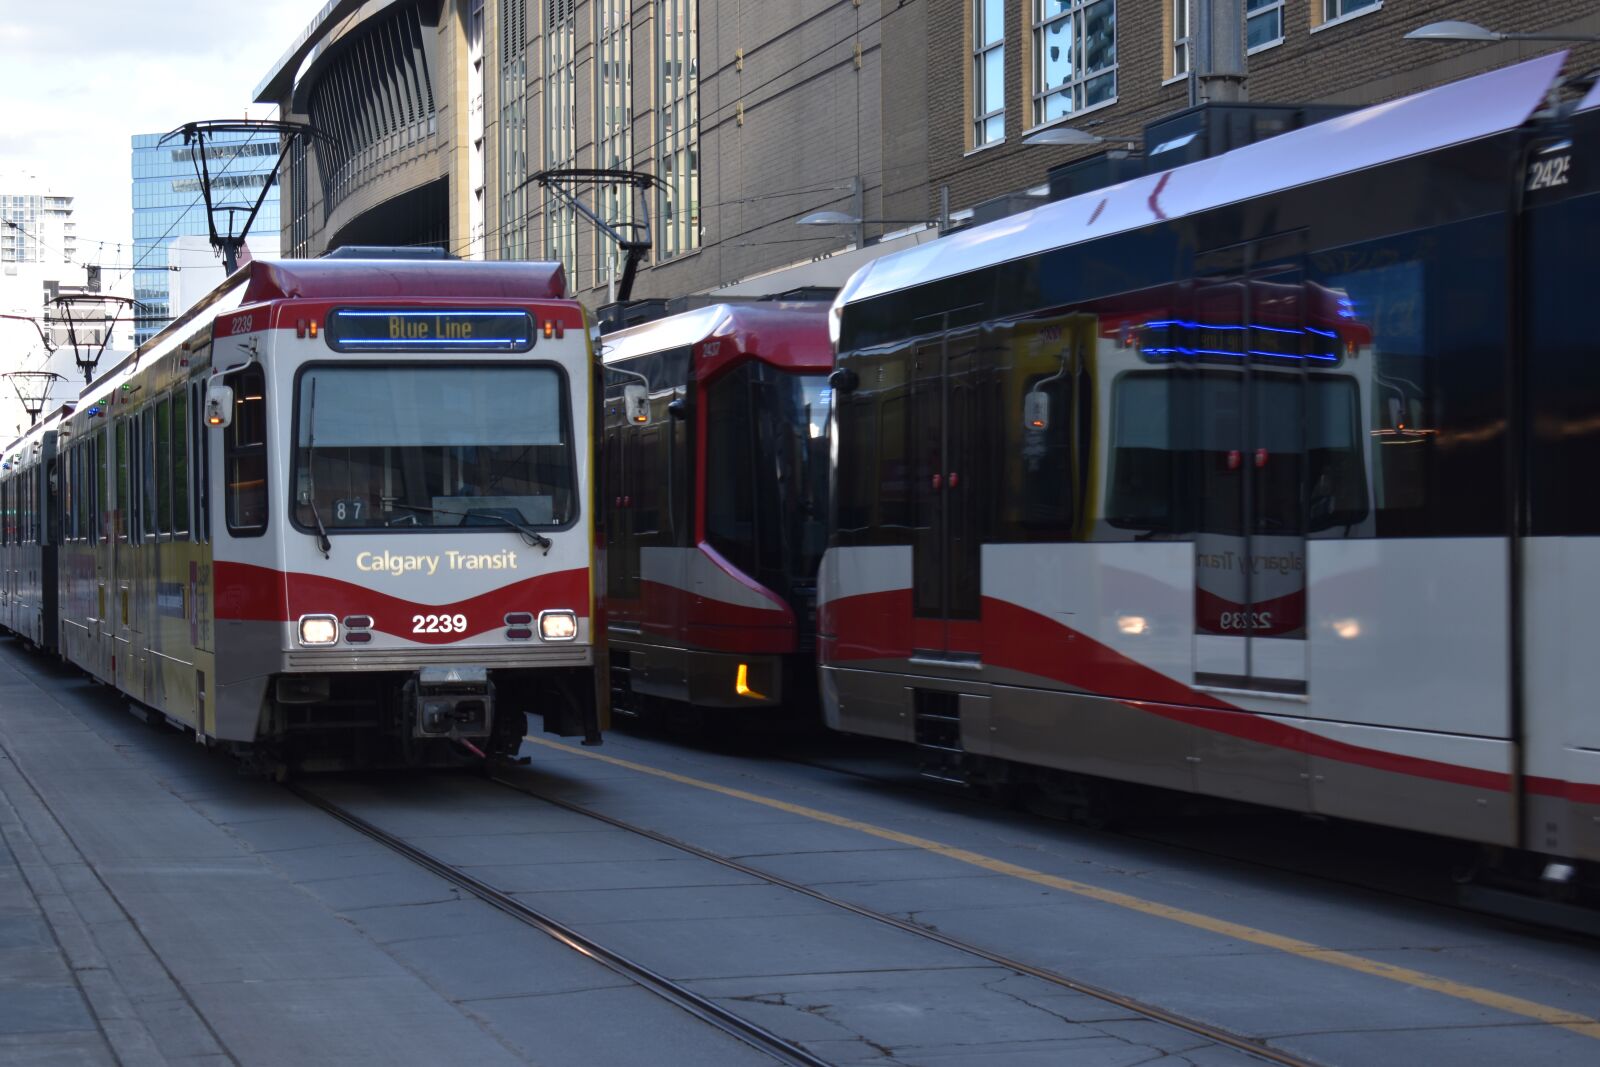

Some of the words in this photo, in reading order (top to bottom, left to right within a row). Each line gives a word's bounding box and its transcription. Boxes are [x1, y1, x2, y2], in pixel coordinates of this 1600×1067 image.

[231, 314, 253, 335] 2239
[389, 315, 428, 339] Blue
[435, 315, 472, 339] Line
[356, 549, 440, 577] Calgary
[445, 548, 518, 570] Transit
[412, 613, 468, 634] 2239
